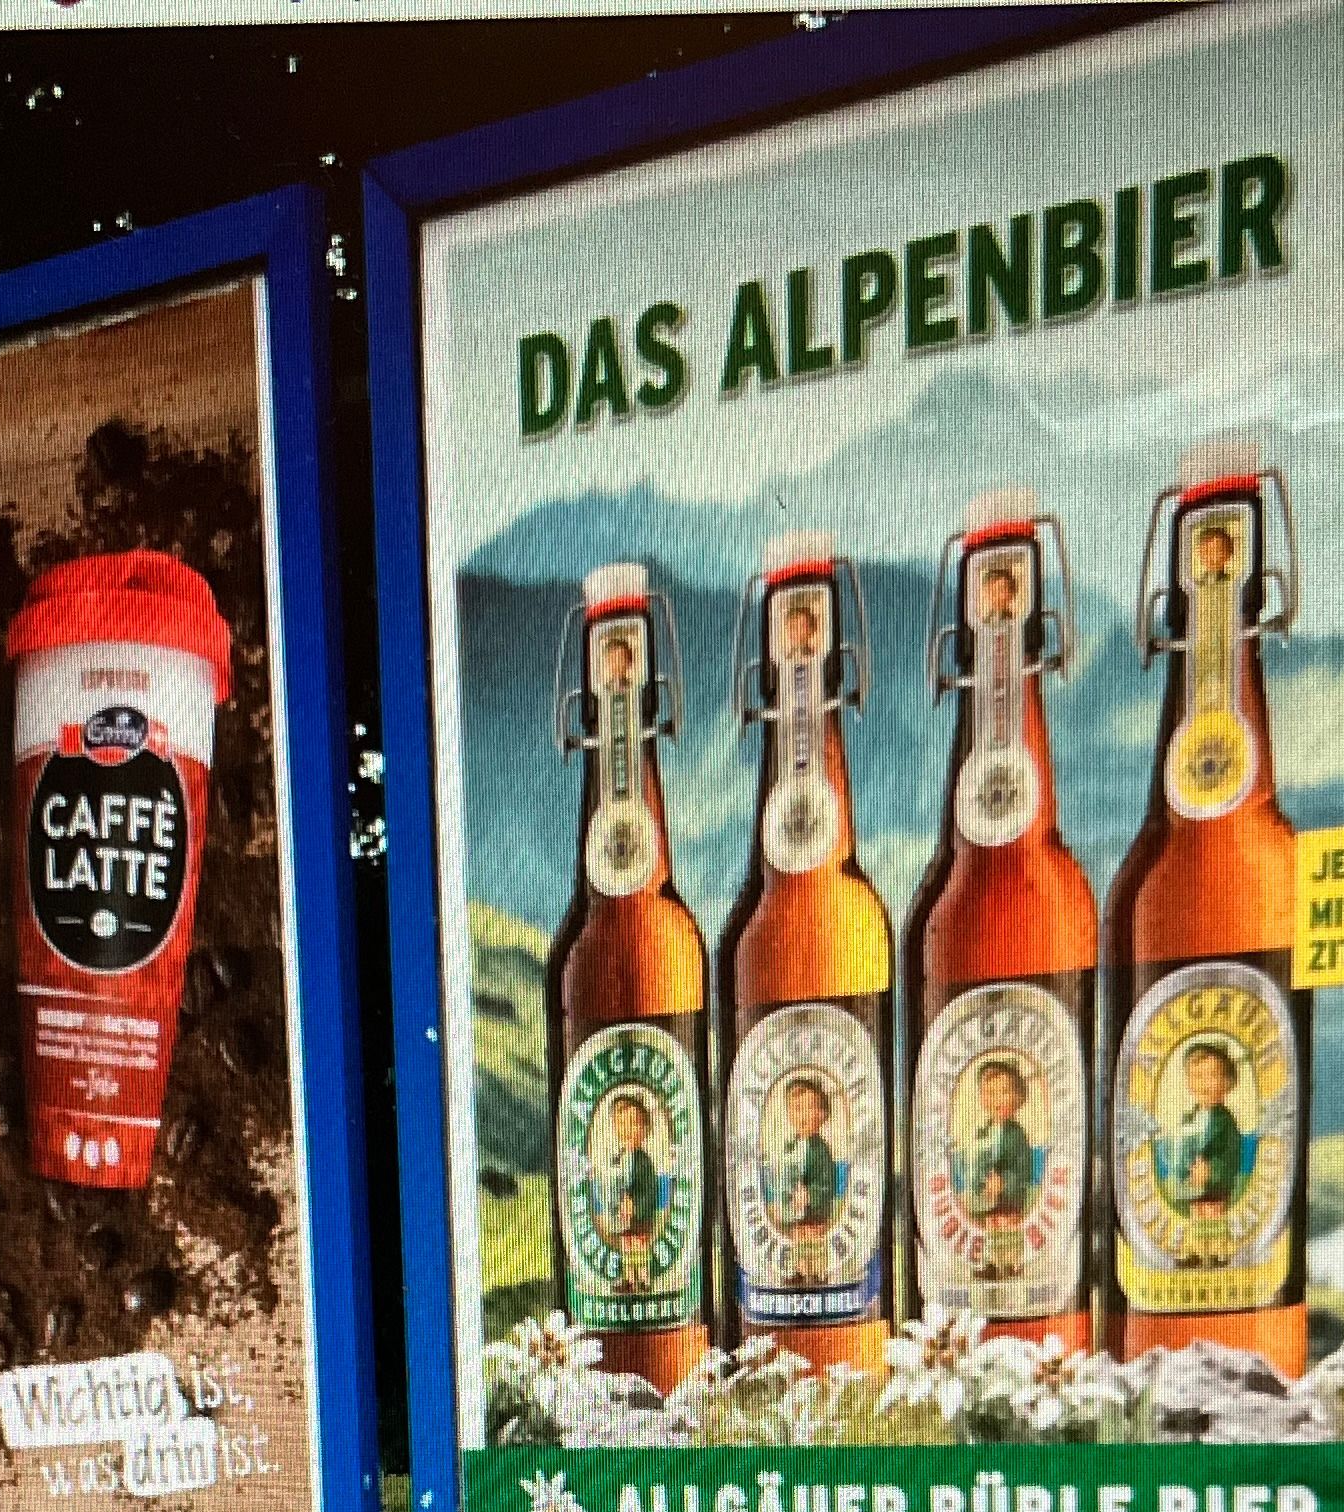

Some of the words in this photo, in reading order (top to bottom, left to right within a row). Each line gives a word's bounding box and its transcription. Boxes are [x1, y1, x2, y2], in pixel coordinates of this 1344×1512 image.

[518, 299, 686, 441] DAS
[720, 153, 1294, 394] ALPENBIER
[40, 790, 178, 850] CAFFÈ
[44, 847, 171, 902] LATTE
[12, 1365, 174, 1432] Wichtig
[40, 1451, 121, 1497] was
[134, 1433, 209, 1488] drin
[221, 1422, 282, 1479] ist.
